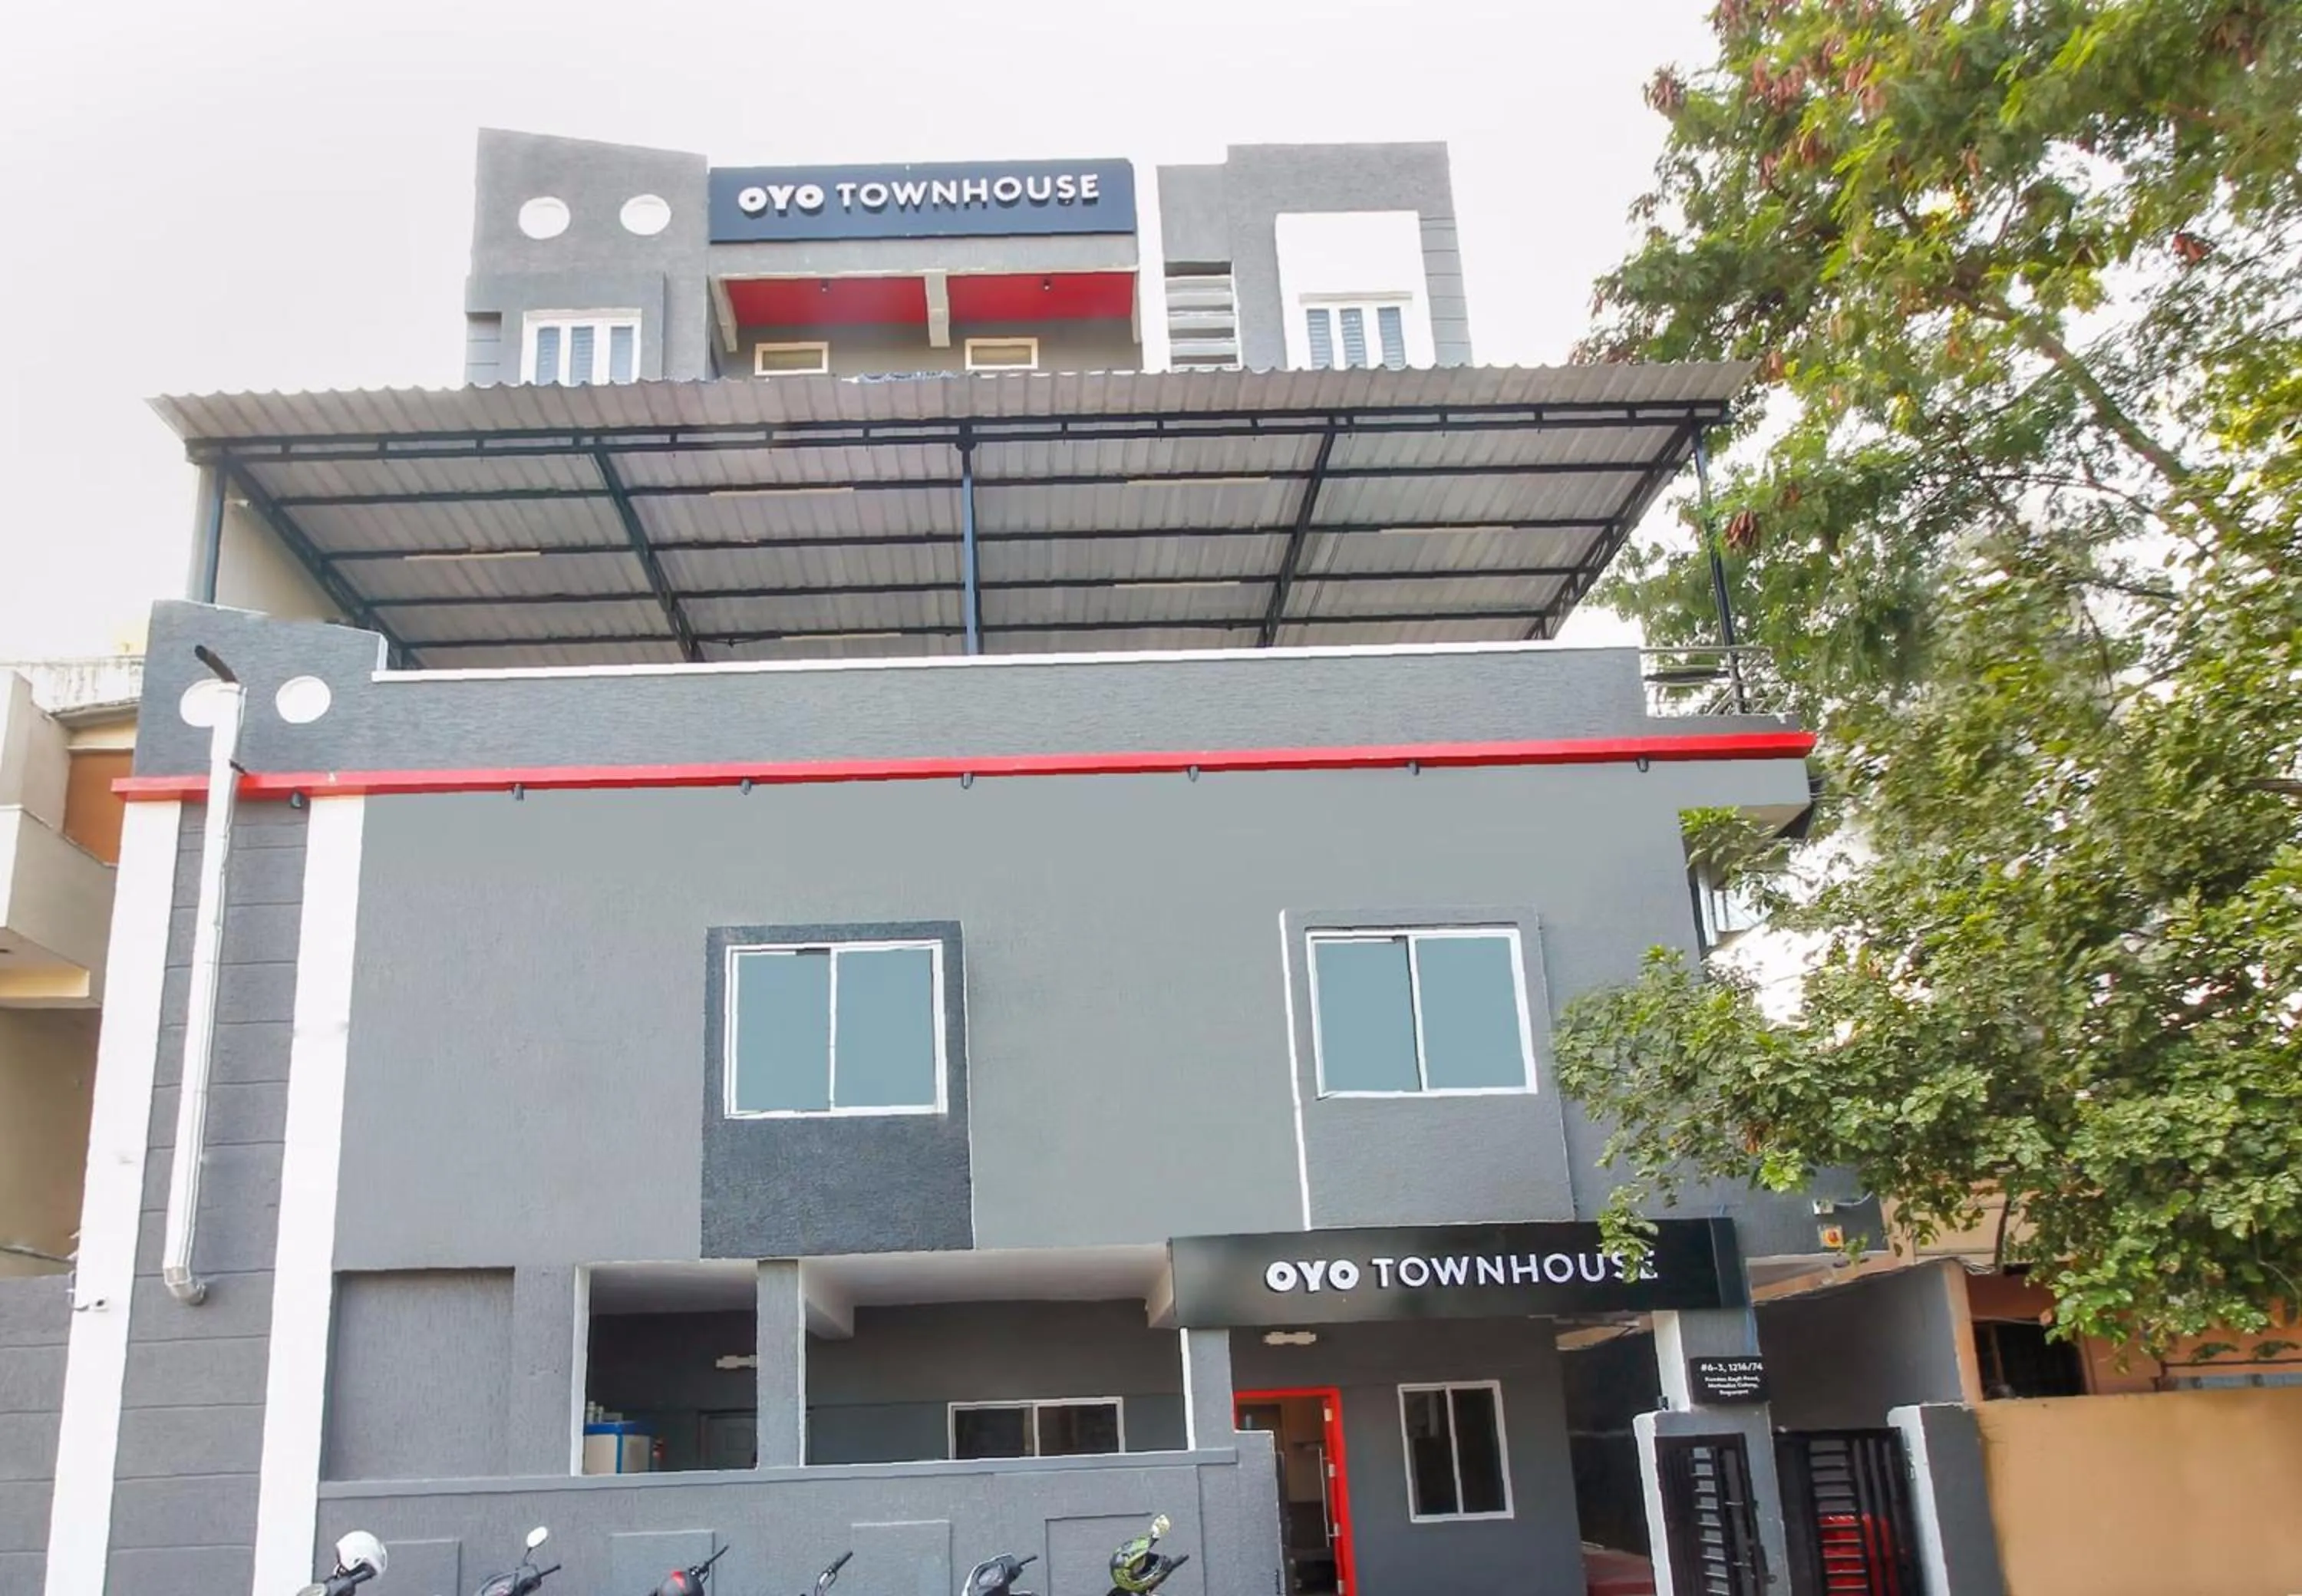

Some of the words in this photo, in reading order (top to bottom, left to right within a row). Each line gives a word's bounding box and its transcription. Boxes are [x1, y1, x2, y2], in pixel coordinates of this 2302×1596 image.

[738, 183, 825, 212] OYO
[836, 174, 1099, 208] TOWNHOUSE
[1265, 1259, 1360, 1292] OYO
